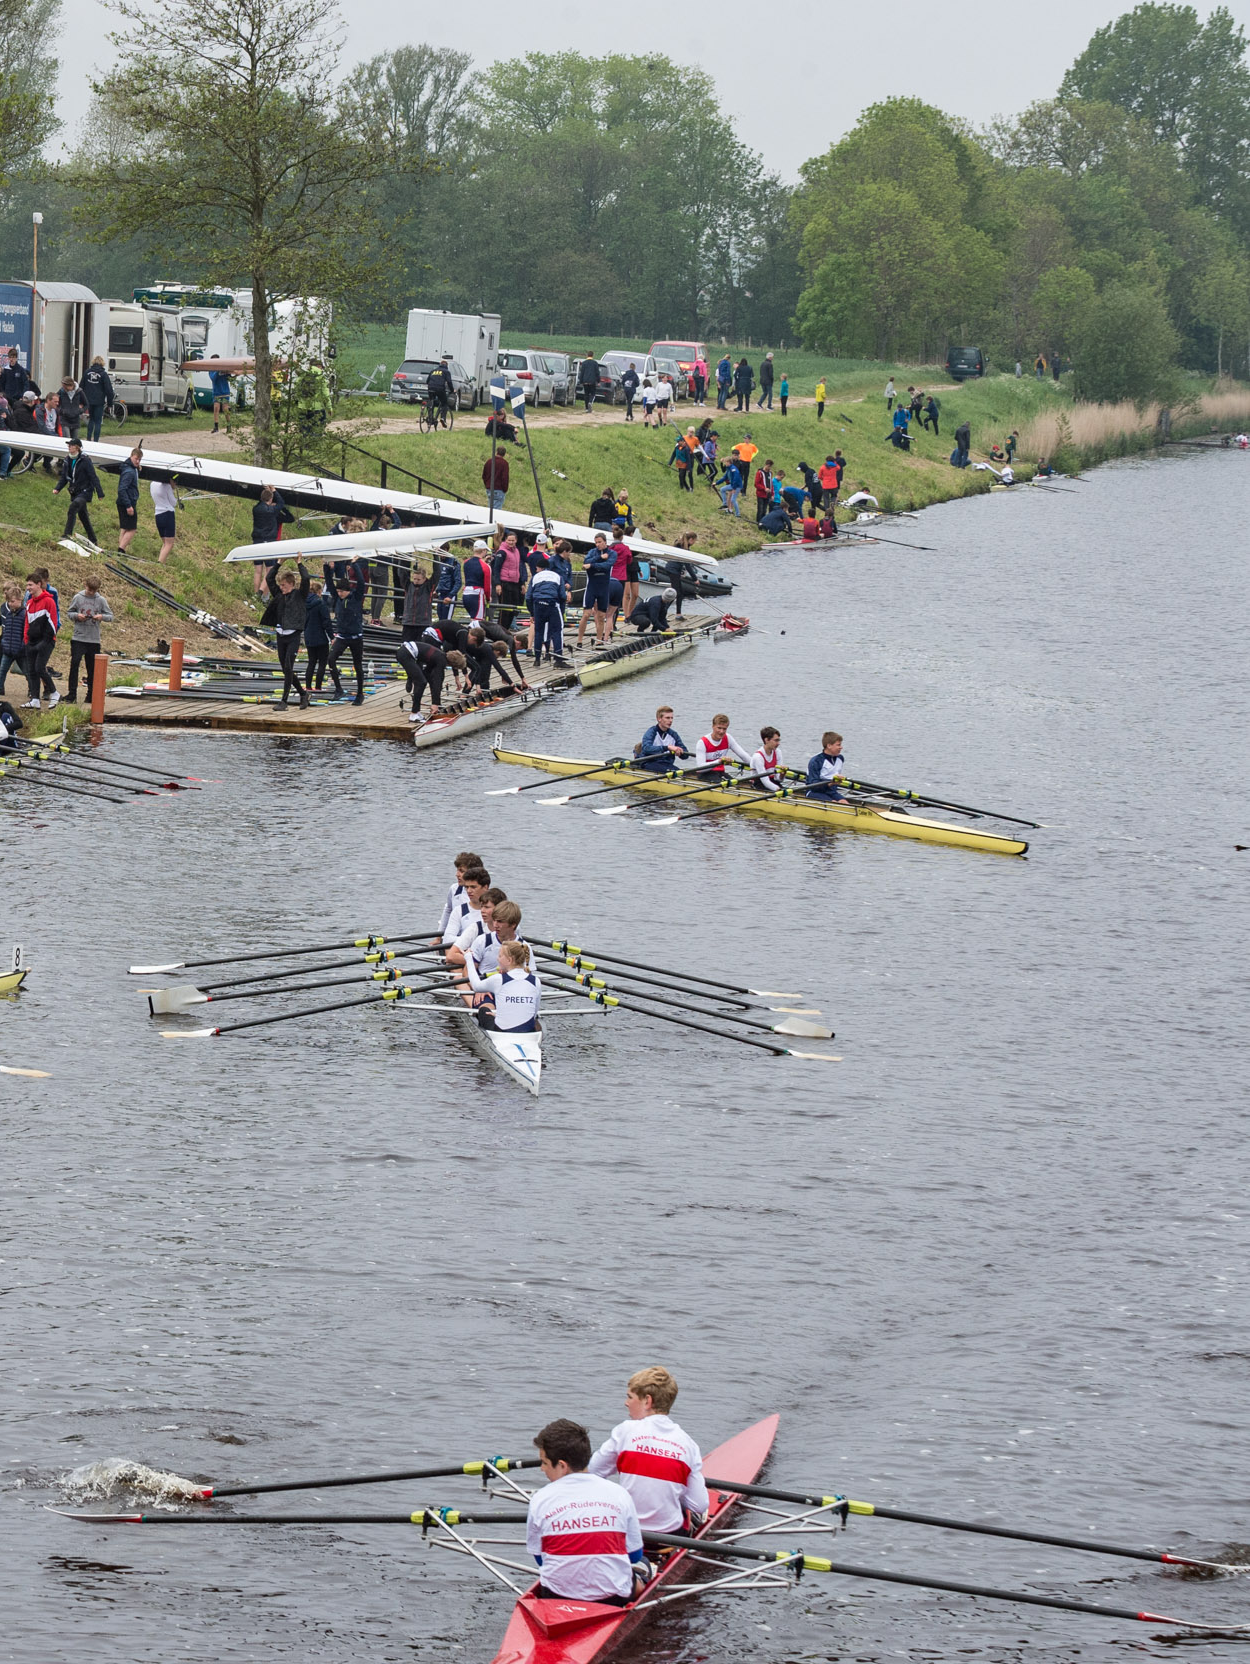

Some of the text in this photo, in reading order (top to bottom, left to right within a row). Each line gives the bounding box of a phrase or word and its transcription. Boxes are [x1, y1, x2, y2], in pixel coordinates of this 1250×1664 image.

[15, 947, 20, 967] 8
[505, 995, 534, 1004] PREETZ
[636, 1444, 682, 1460] HANSEAT
[544, 1501, 622, 1519] Alster-Ruderverein
[551, 1516, 617, 1532] HANSEAT
